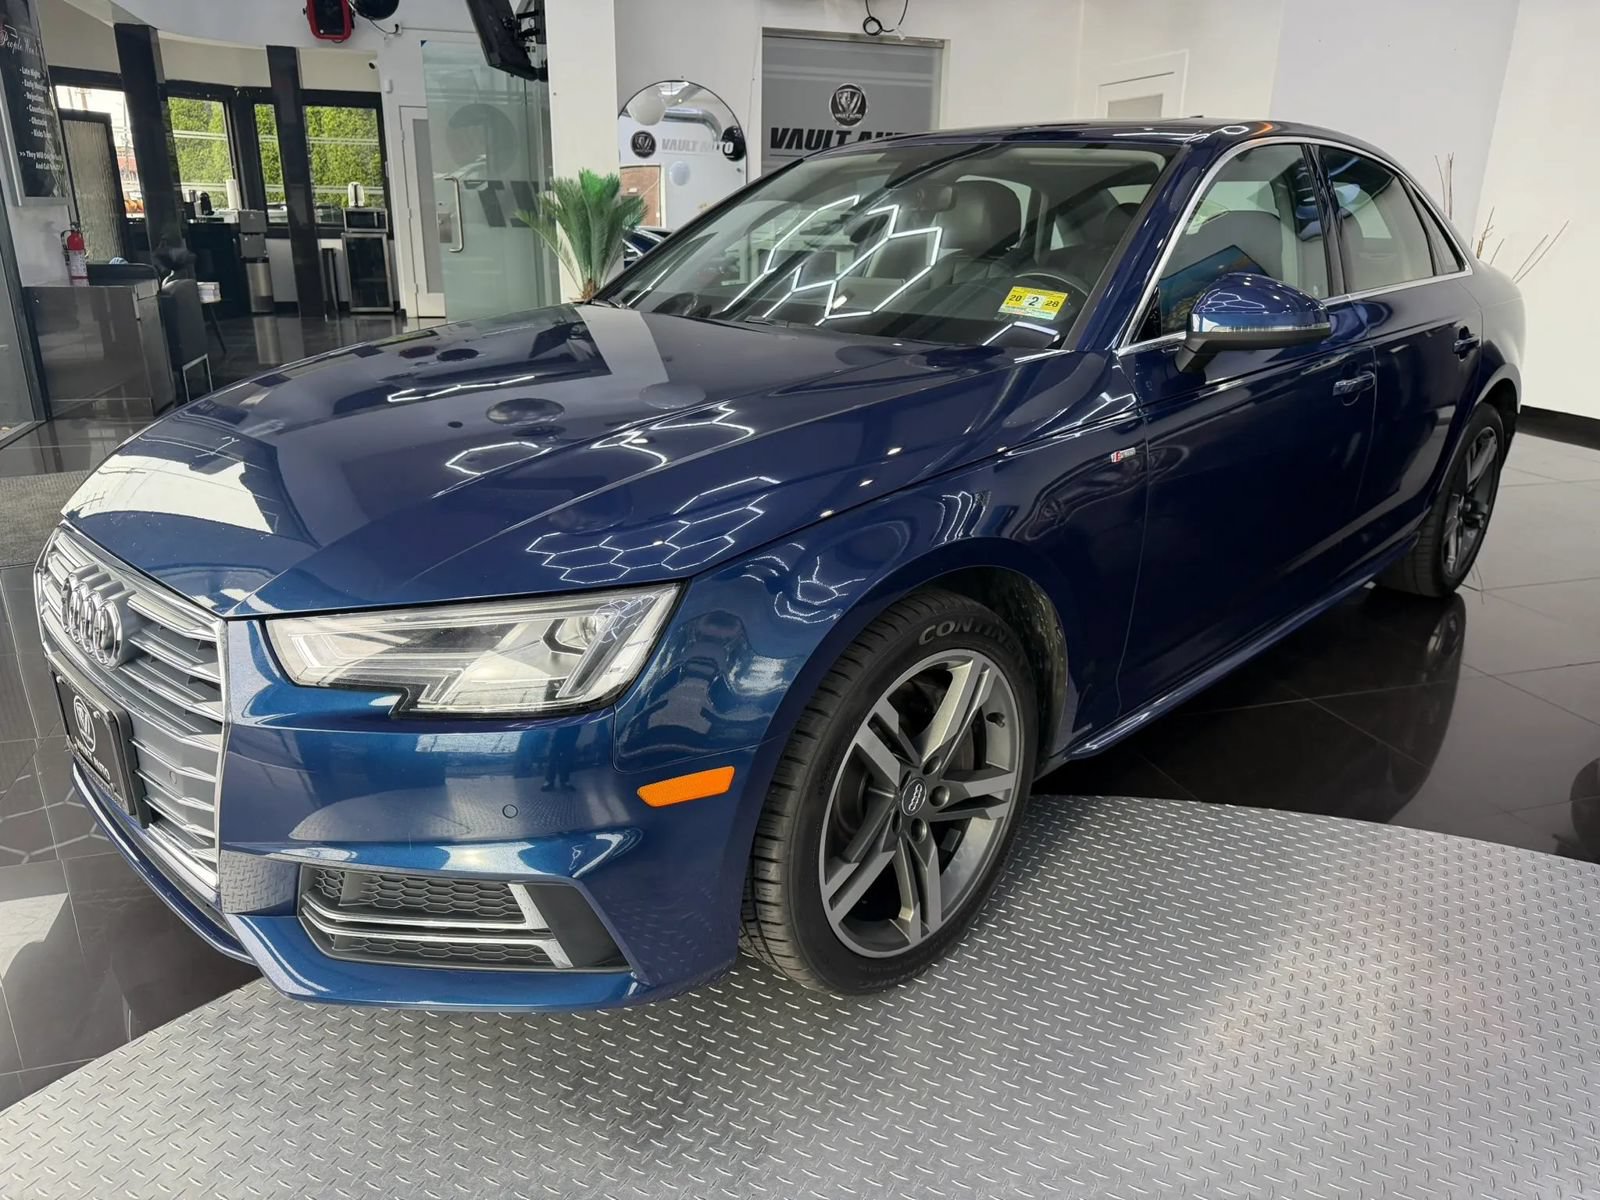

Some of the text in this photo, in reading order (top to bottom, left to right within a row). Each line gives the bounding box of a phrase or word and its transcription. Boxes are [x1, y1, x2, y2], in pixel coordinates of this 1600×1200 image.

[661, 138, 697, 152] VAULT
[770, 127, 852, 150] VAULT
[1028, 296, 1040, 307] 2
